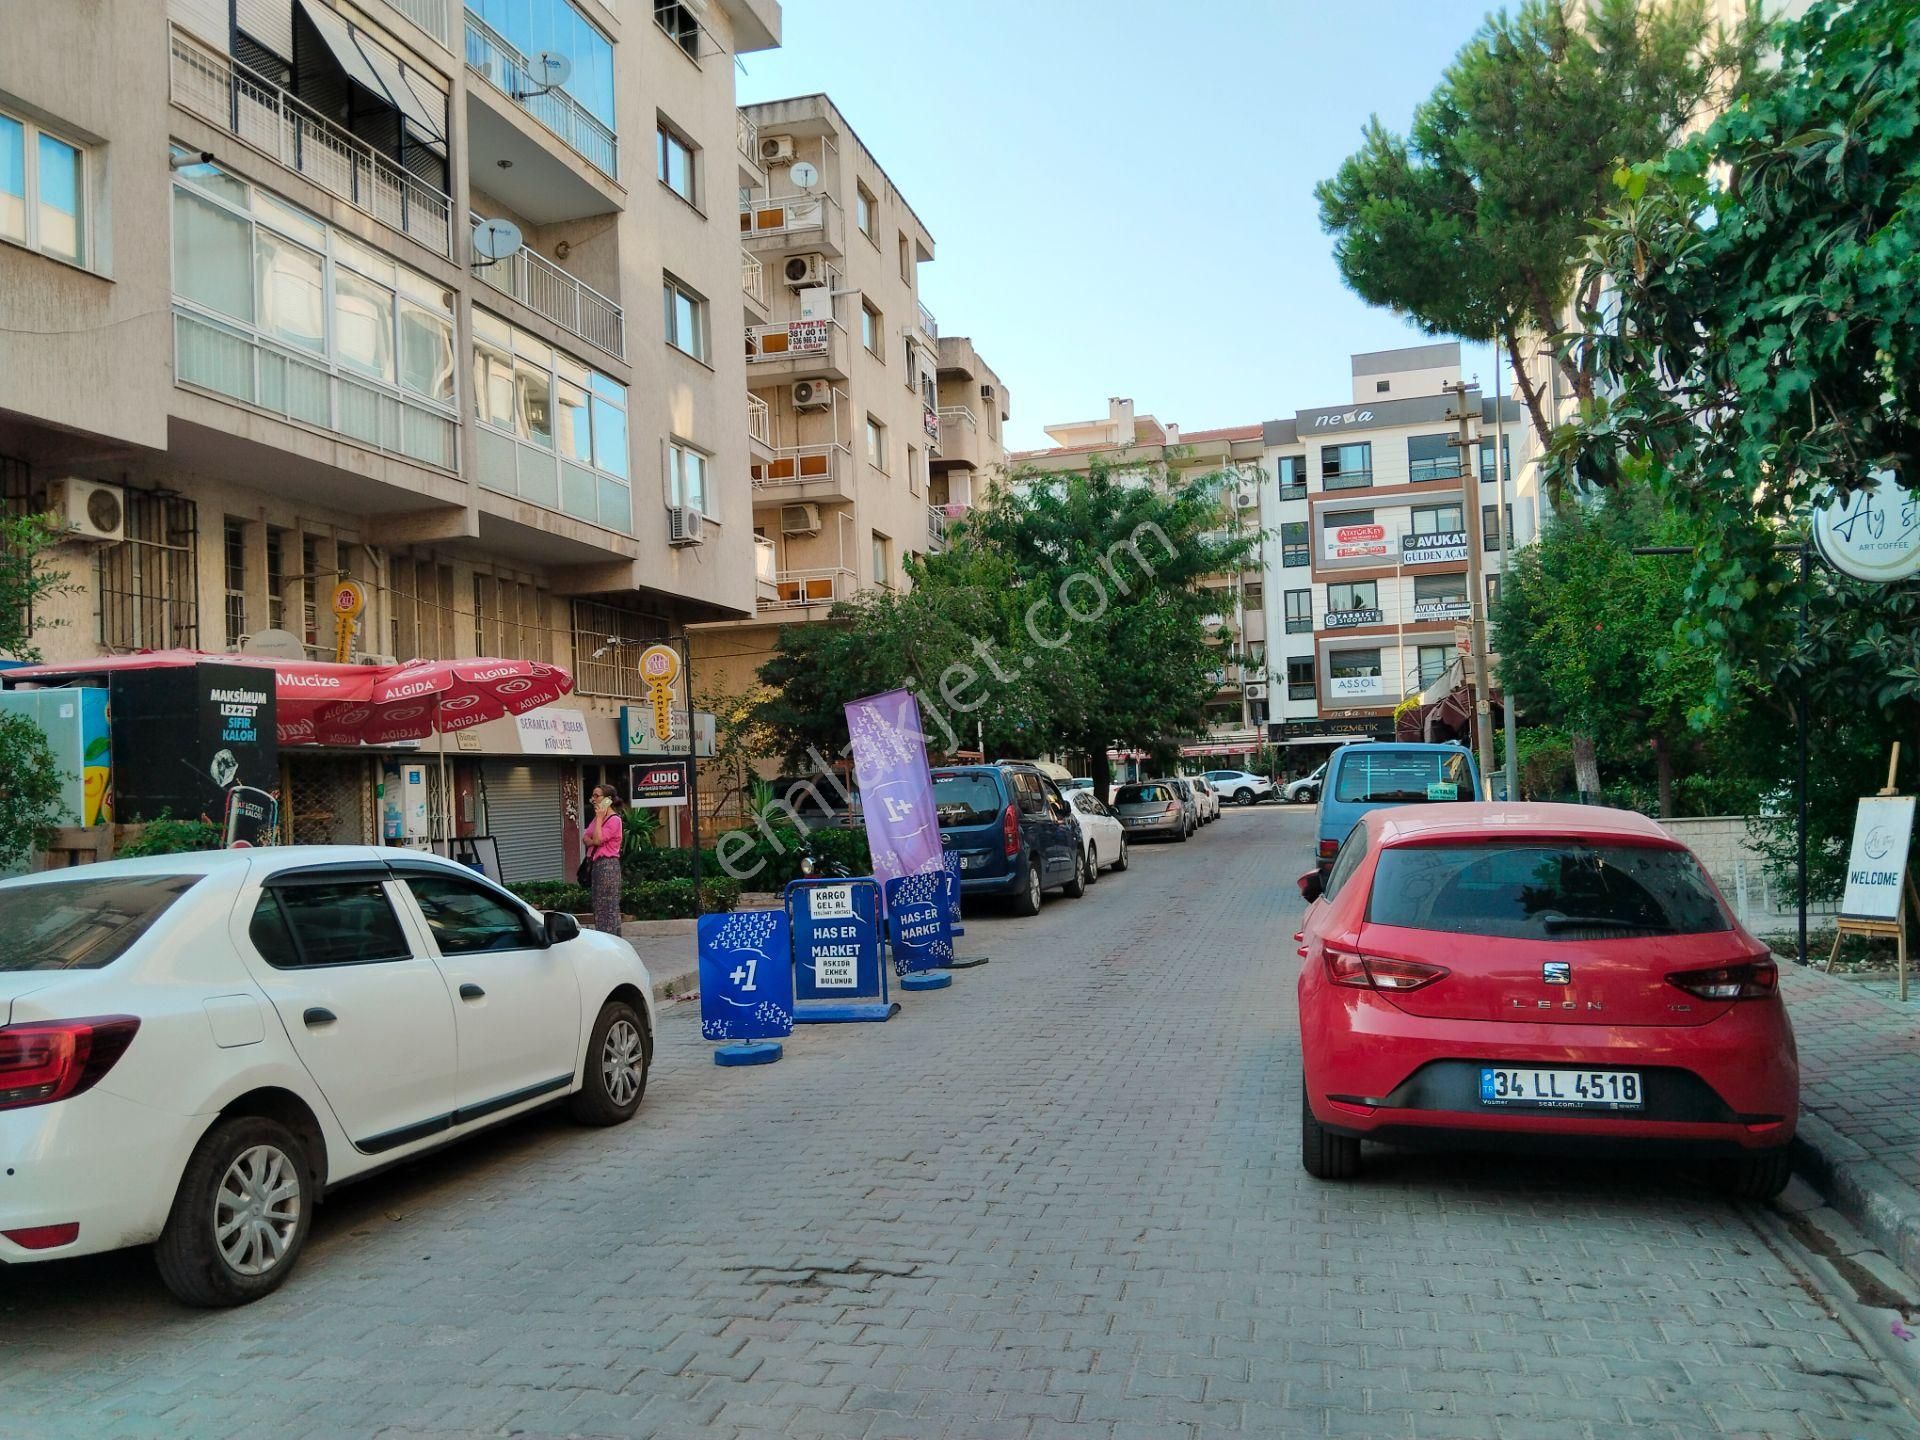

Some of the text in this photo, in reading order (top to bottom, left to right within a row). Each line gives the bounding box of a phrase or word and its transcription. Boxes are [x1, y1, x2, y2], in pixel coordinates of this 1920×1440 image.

[805, 328, 816, 336] 00
[1416, 533, 1467, 548] AVUKAT
[1859, 541, 1909, 551] ART COFFEE
[1415, 603, 1447, 613] AVUKAT
[276, 674, 340, 688] Mucize
[1338, 679, 1377, 689] ASSOL
[211, 688, 267, 704] MAKSİMUM
[220, 703, 258, 717] LEZZET
[228, 716, 251, 729] SIFIR
[222, 728, 257, 742] KALORİ
[639, 769, 680, 786] AUDIO
[1851, 871, 1898, 886] WELCOME
[816, 890, 846, 901] KARGO
[816, 900, 847, 910] GEL AL
[900, 908, 938, 925] HAS-ER
[813, 926, 857, 939] HAS ER
[901, 921, 941, 940] MARKET
[811, 943, 861, 957] MARKET
[729, 959, 757, 991] +1
[1513, 1000, 1602, 1010] LEON
[1495, 1072, 1637, 1101] 34 LL 4518
